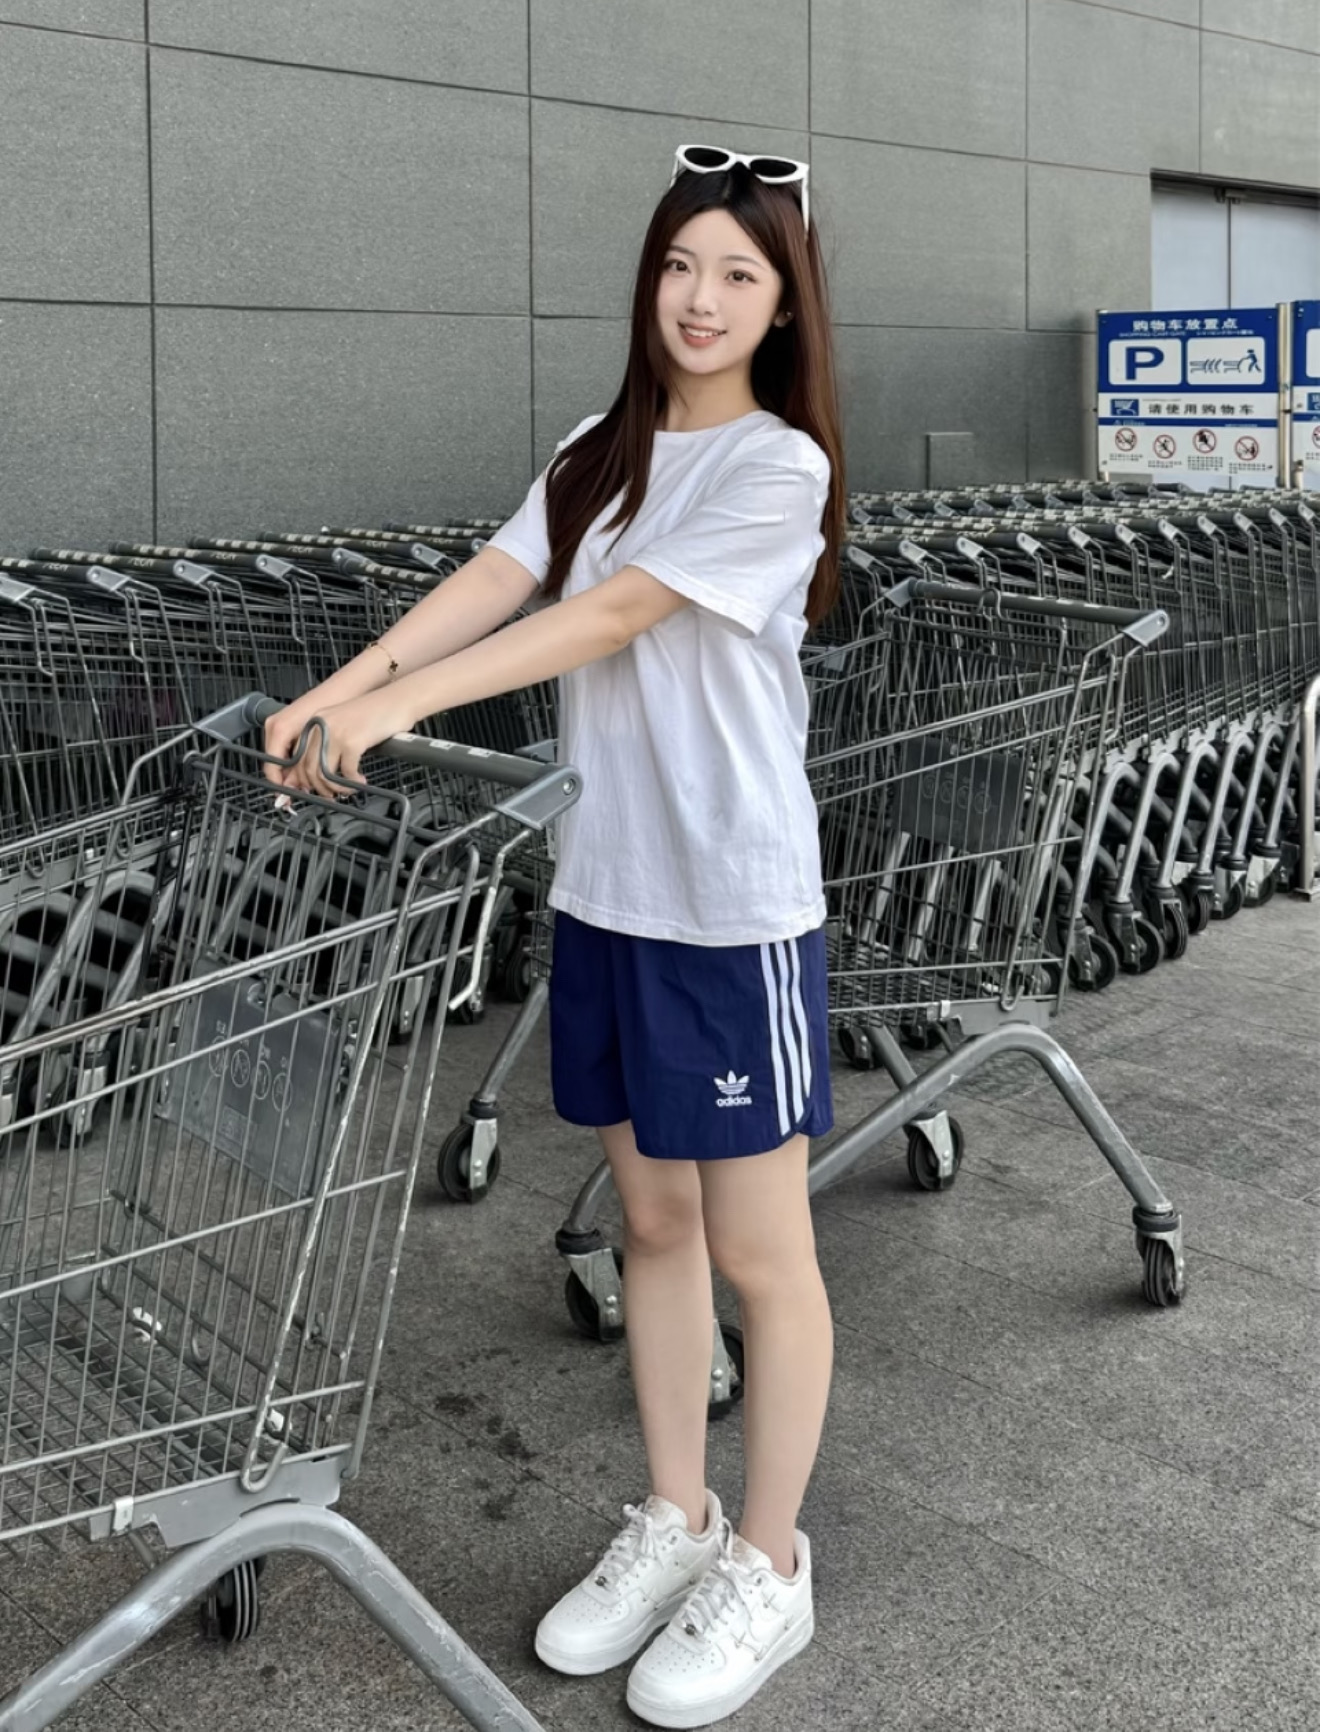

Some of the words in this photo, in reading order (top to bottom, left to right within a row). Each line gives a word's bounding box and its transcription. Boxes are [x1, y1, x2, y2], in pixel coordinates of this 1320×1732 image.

[1132, 318, 1238, 331] 购物车放置点
[1125, 346, 1165, 381] P
[1148, 404, 1254, 416] 请使用购物车
[716, 1095, 752, 1107] adidas
